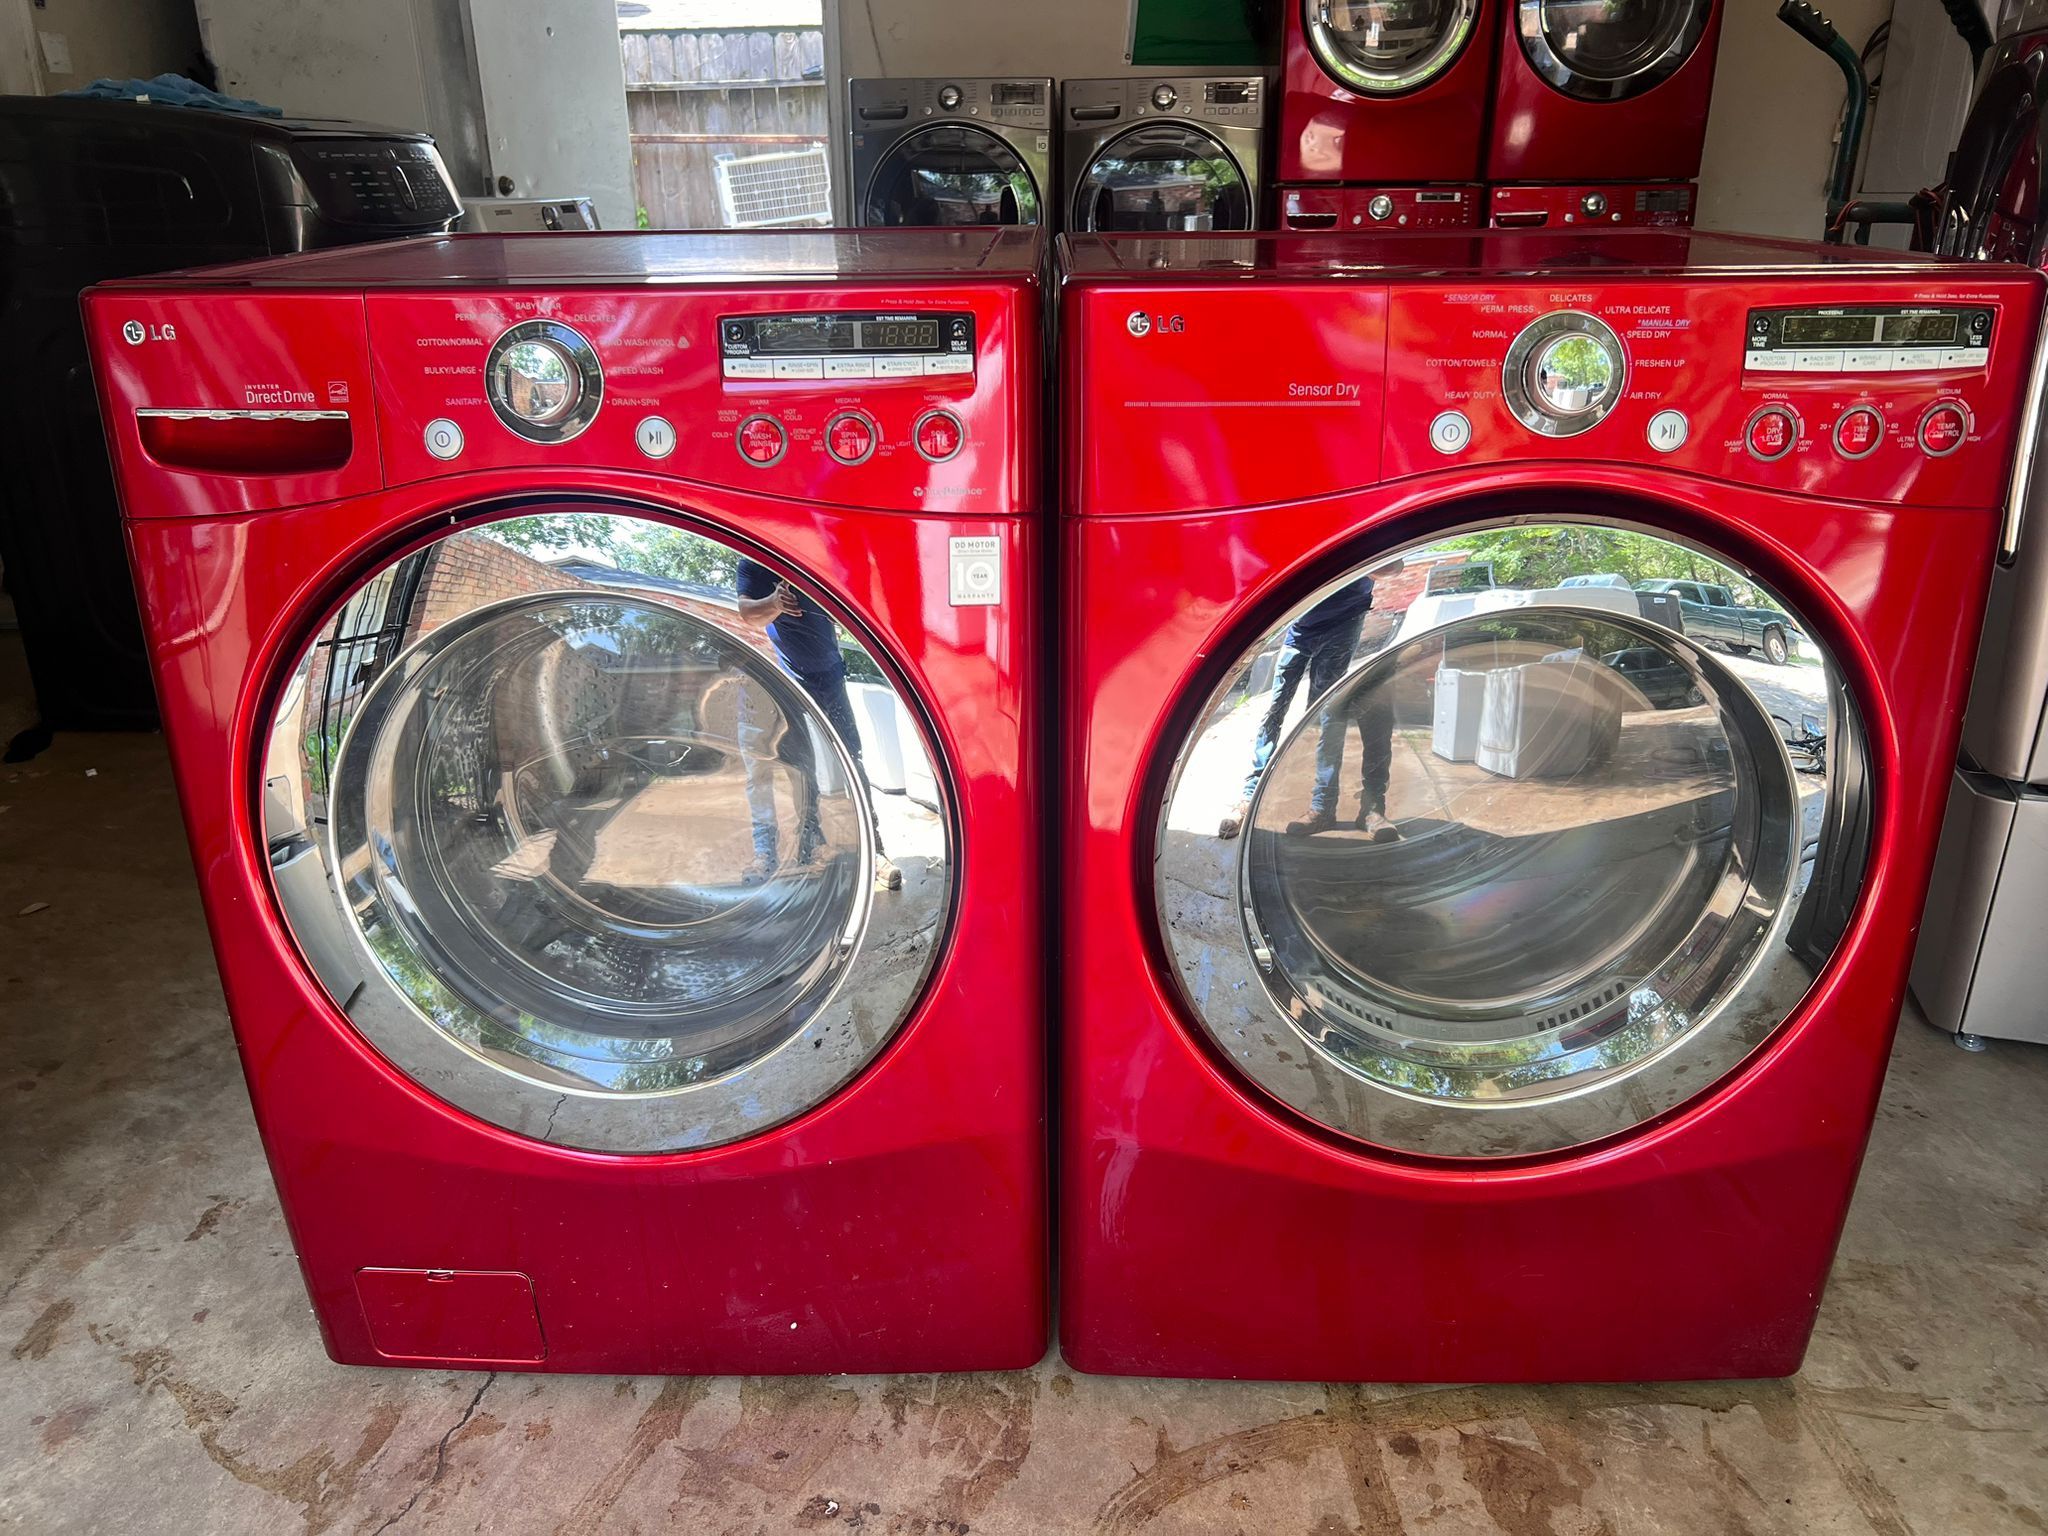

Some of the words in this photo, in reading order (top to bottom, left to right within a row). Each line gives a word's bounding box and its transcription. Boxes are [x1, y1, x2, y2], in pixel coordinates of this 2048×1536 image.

[1480, 294, 1496, 302] DRY
[1550, 294, 1592, 303] DELICATES
[516, 302, 535, 310] BABY
[1507, 305, 1534, 314] PRESS
[1605, 306, 1632, 314] ULTRA
[1632, 306, 1670, 314] DELICATE
[574, 314, 616, 322] DELICATES
[1158, 315, 1184, 333] LG
[151, 324, 176, 341] LG
[1472, 330, 1508, 338] NORMAL
[1626, 330, 1652, 339] SPEED
[1654, 330, 1671, 339] DRY
[416, 338, 484, 347] COTTON/NORMAL
[1426, 359, 1497, 368] COTTON/TOWELS
[1635, 360, 1671, 368] FRESHEN
[1674, 360, 1686, 368] UP
[424, 366, 477, 375] BULKY/LARGE
[1288, 382, 1333, 396] Sensor
[1336, 383, 1360, 399] Dry
[246, 390, 283, 404] Direct
[284, 390, 315, 403] Drive
[1473, 391, 1496, 400] DUTY
[1630, 392, 1645, 400] AIR
[1646, 392, 1662, 400] DRY
[445, 398, 482, 406] SANITARY
[612, 398, 660, 406] DRAIN+SPIN
[968, 541, 996, 549] MOTOR
